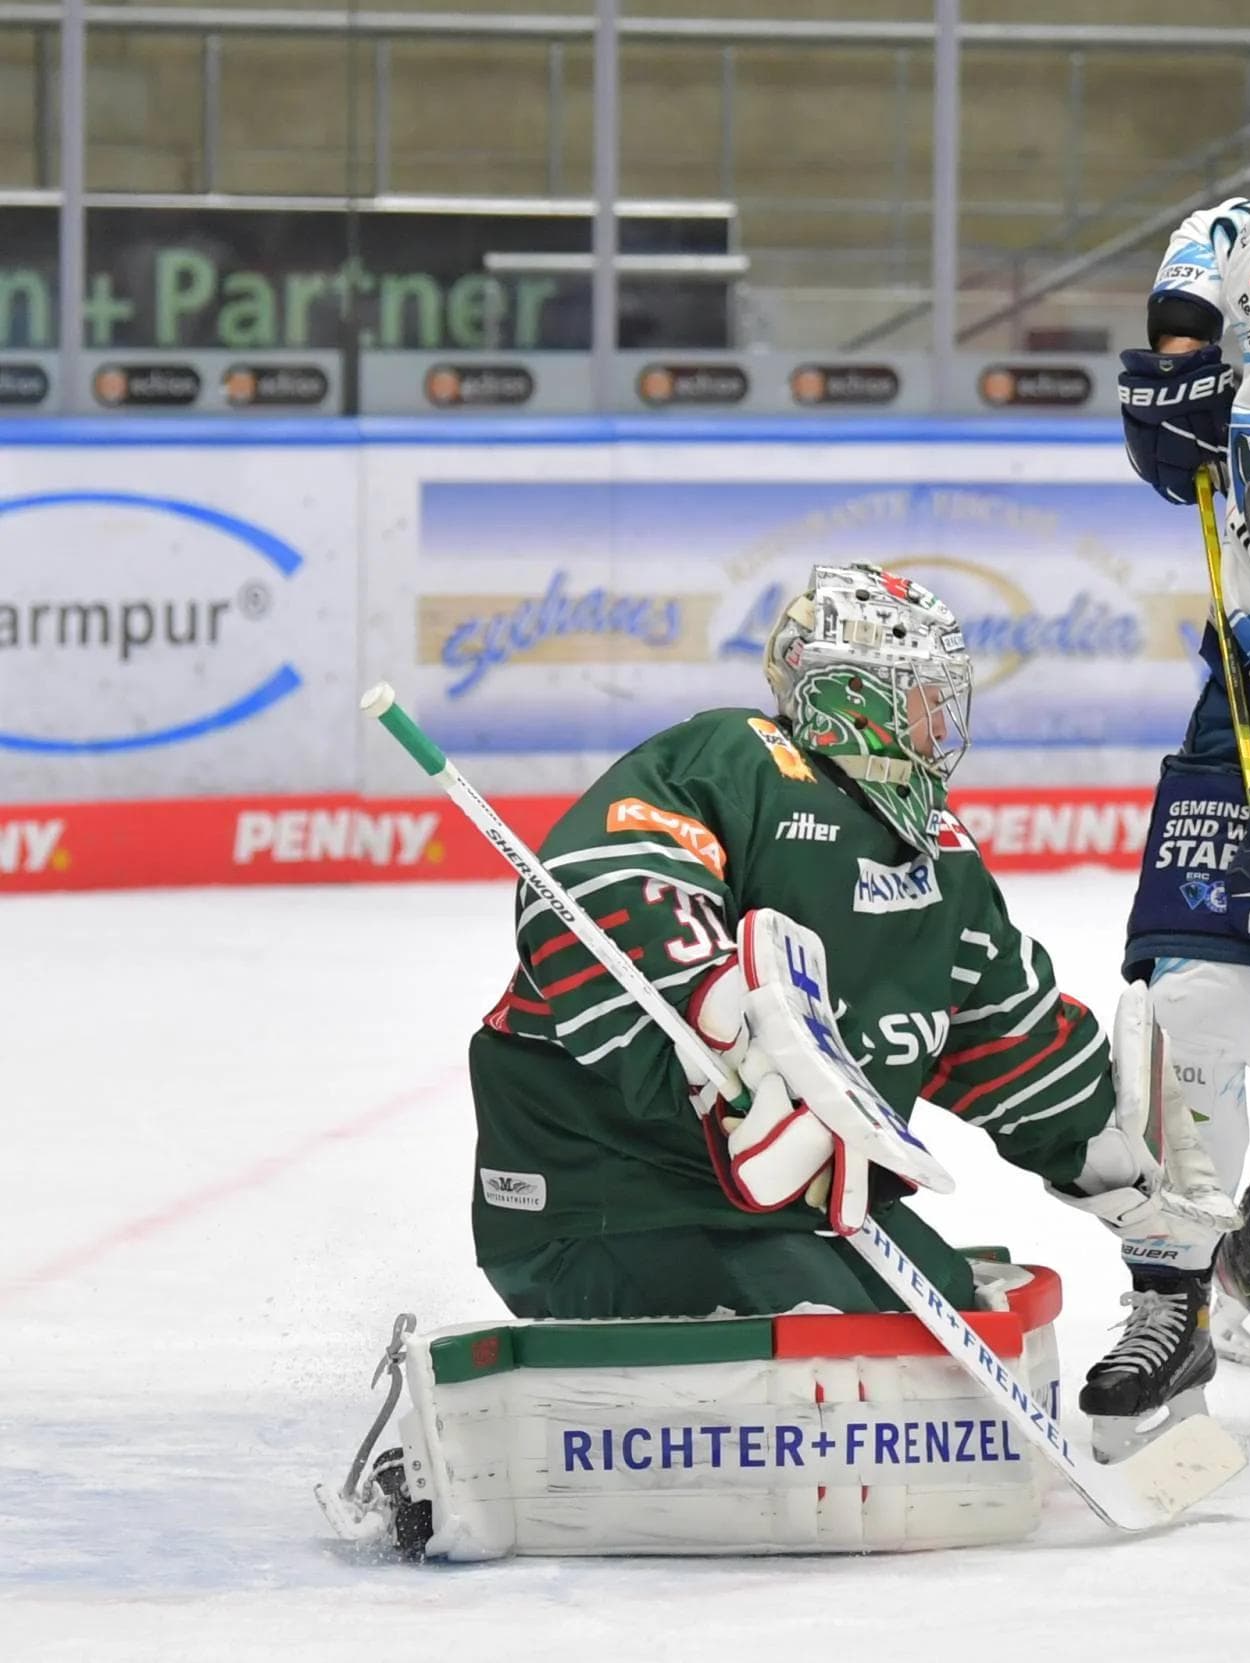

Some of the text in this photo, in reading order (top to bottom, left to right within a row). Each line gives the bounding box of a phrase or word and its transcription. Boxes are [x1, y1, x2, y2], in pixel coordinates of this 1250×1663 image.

[155, 247, 557, 349] Partner
[1117, 364, 1242, 408] BAUER
[232, 812, 445, 866] PENNY.
[615, 803, 724, 868] KUKA
[775, 812, 841, 842] ritter
[1163, 819, 1220, 838] SIND
[1186, 872, 1210, 881] ERC
[643, 877, 737, 965] 31
[561, 1419, 1021, 1473] RICHTER+FRENZEL
